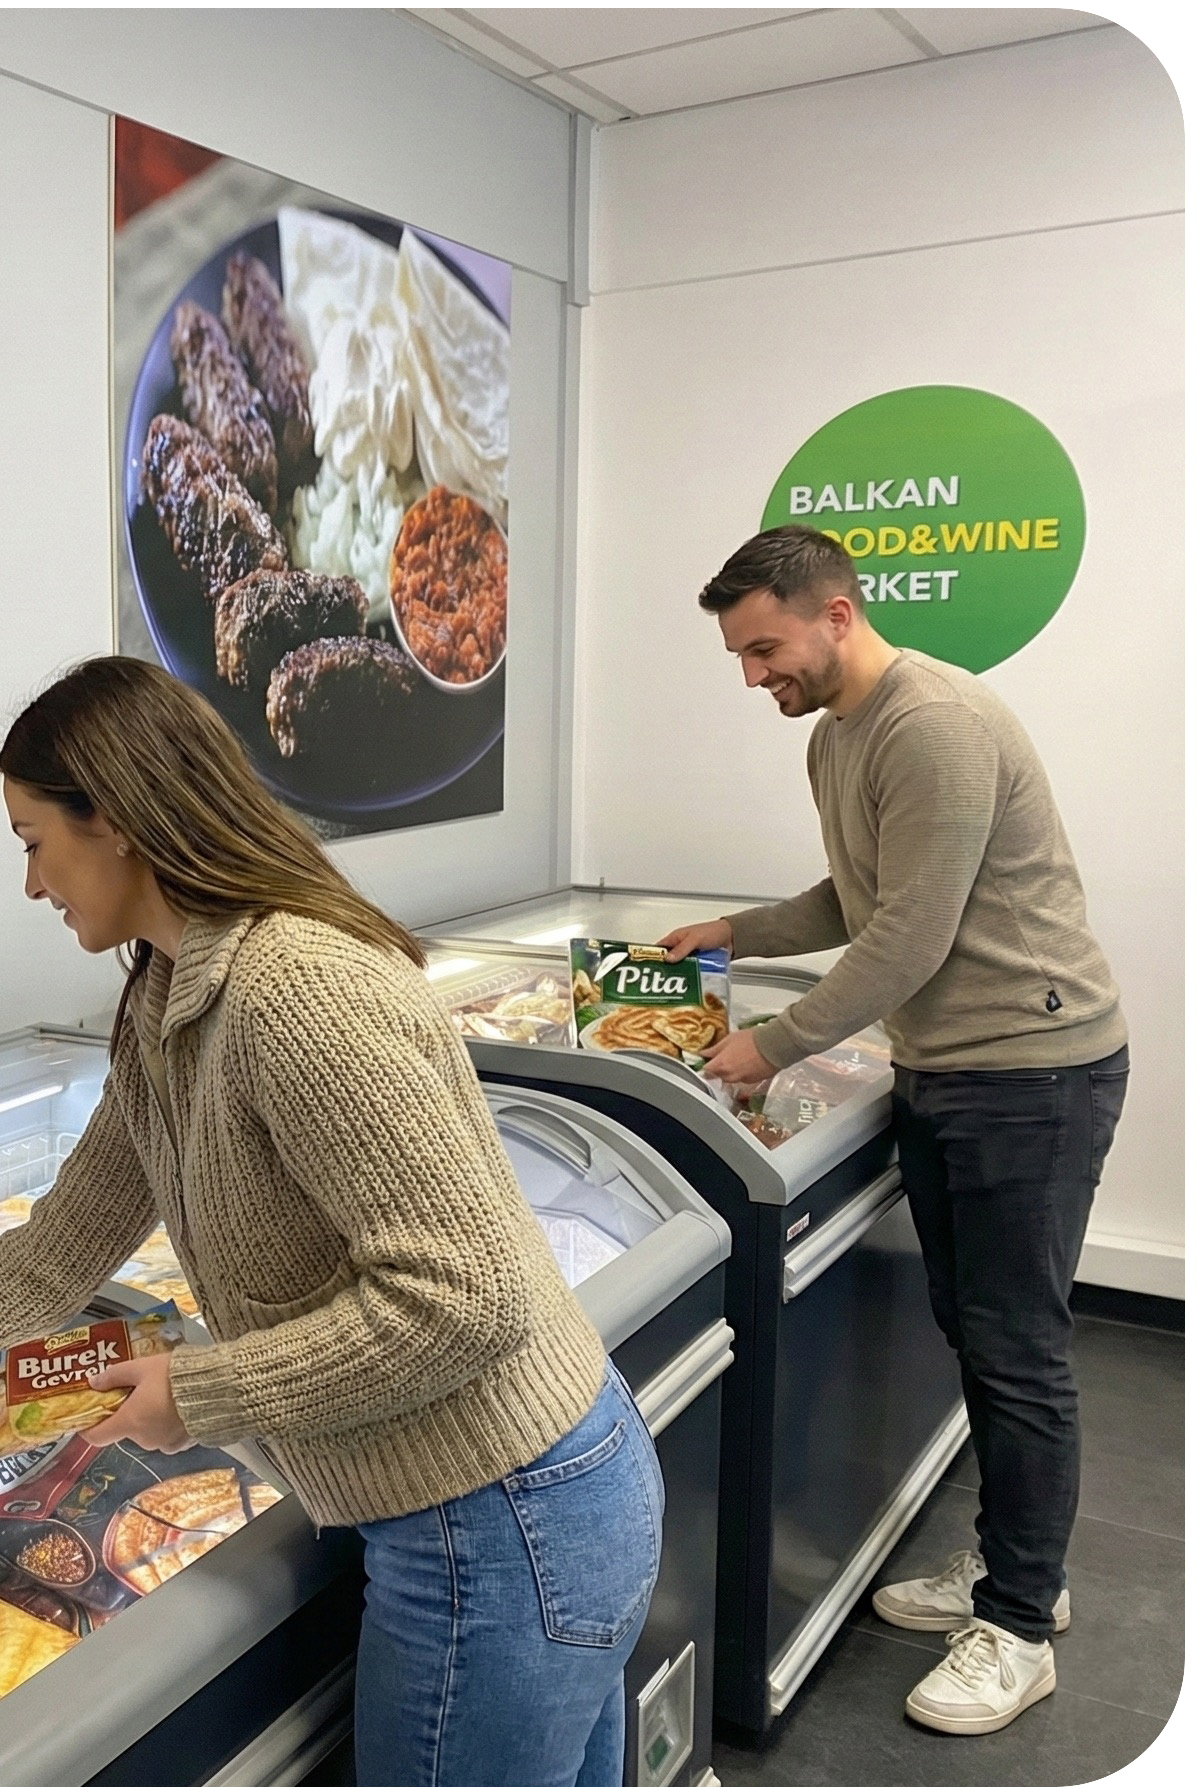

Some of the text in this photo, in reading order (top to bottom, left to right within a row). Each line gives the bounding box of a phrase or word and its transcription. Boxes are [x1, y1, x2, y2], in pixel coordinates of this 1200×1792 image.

[789, 476, 959, 515] BALKAN
[857, 570, 959, 602] RKET
[616, 965, 688, 994] Pita
[18, 1339, 121, 1379] Burek
